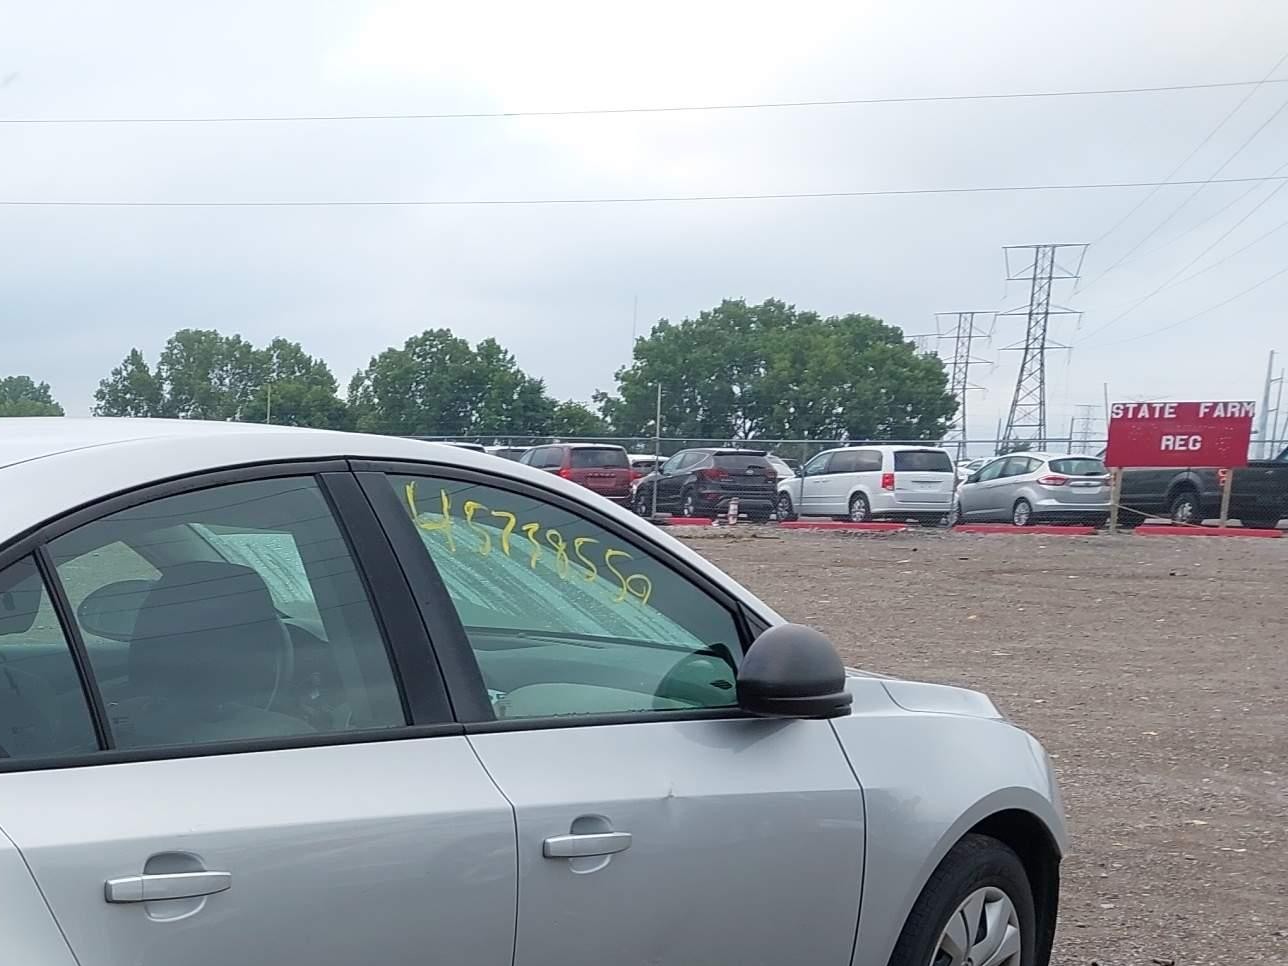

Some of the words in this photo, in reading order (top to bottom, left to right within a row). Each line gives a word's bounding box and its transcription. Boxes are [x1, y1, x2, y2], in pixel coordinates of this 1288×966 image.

[1112, 404, 1178, 418] STATE
[1198, 402, 1255, 418] FARM
[1160, 435, 1202, 450] REG
